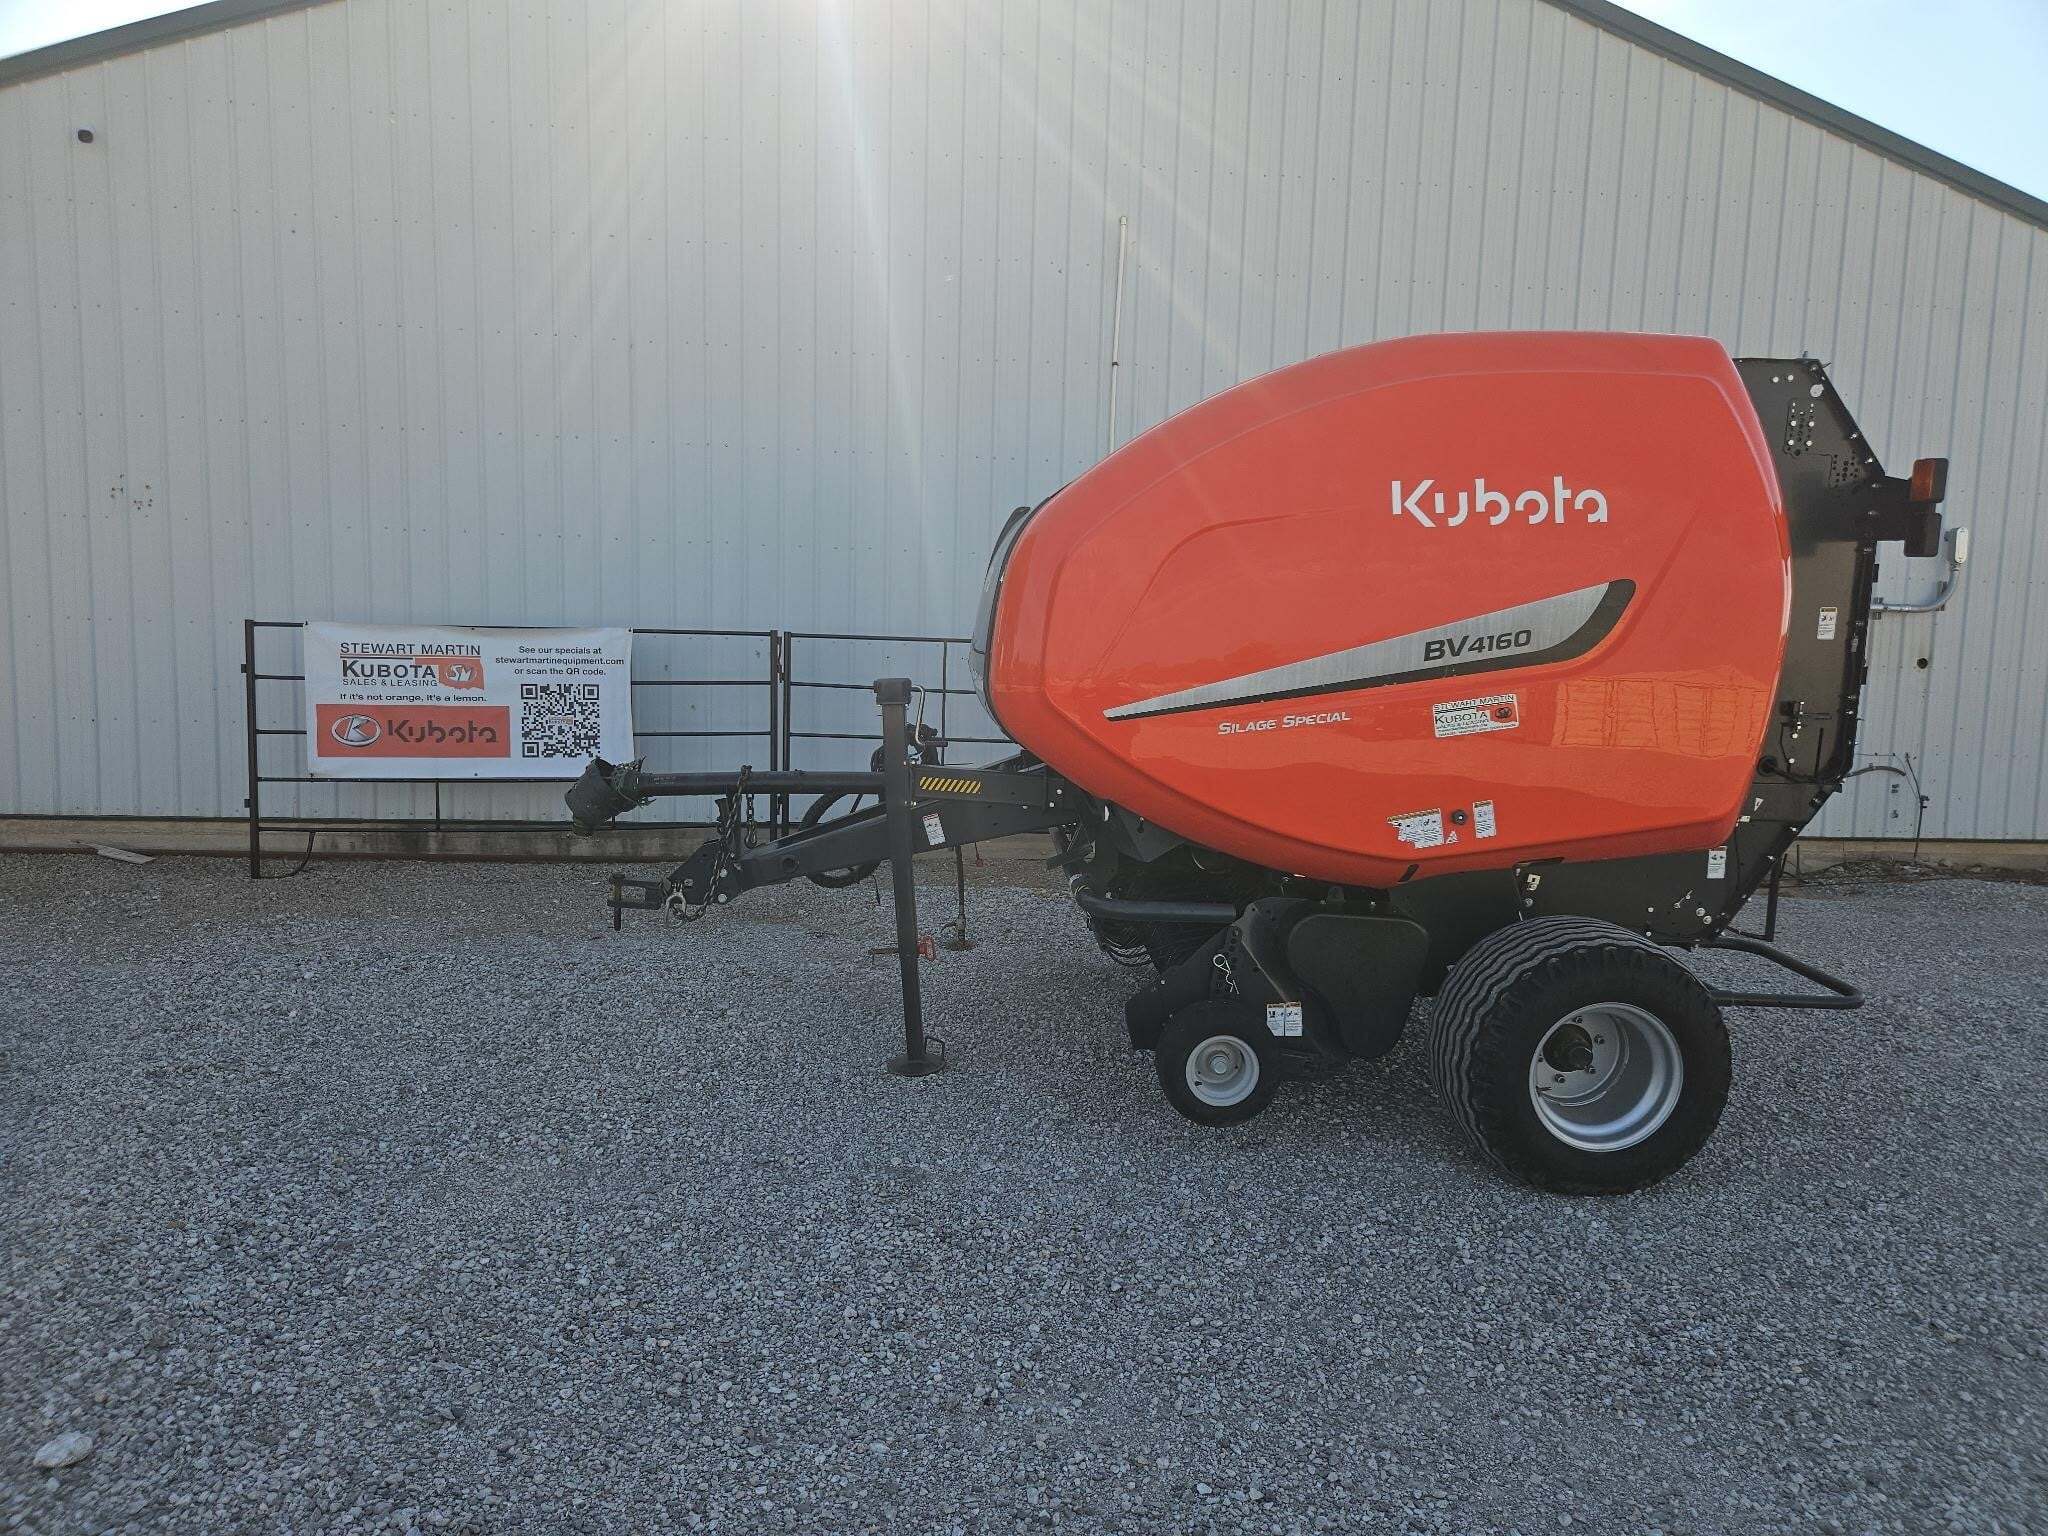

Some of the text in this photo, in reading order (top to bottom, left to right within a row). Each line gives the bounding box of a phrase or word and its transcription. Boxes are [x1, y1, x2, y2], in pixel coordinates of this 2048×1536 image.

[1391, 475, 1608, 528] Kubota
[340, 642, 481, 656] STEWART MARTIN
[519, 646, 536, 654] See
[555, 646, 591, 656] specials
[592, 647, 602, 655] at
[1423, 629, 1532, 662] BV4160
[495, 656, 625, 666] stewartmartinequipment.com
[342, 659, 437, 679] KUBOTA
[526, 667, 548, 675] scan
[549, 667, 564, 675] the
[565, 667, 580, 676] QR
[582, 668, 607, 676] code.
[342, 678, 438, 687] SALES & LEASING
[349, 693, 364, 701] it's
[367, 693, 383, 701] not
[385, 694, 424, 703] orange,
[426, 694, 444, 702] it's
[453, 694, 487, 703] lemon.
[1217, 711, 1353, 735] SILAGE SPECIAL
[1434, 711, 1488, 725] KUBOTA
[387, 719, 498, 743] Kubota
